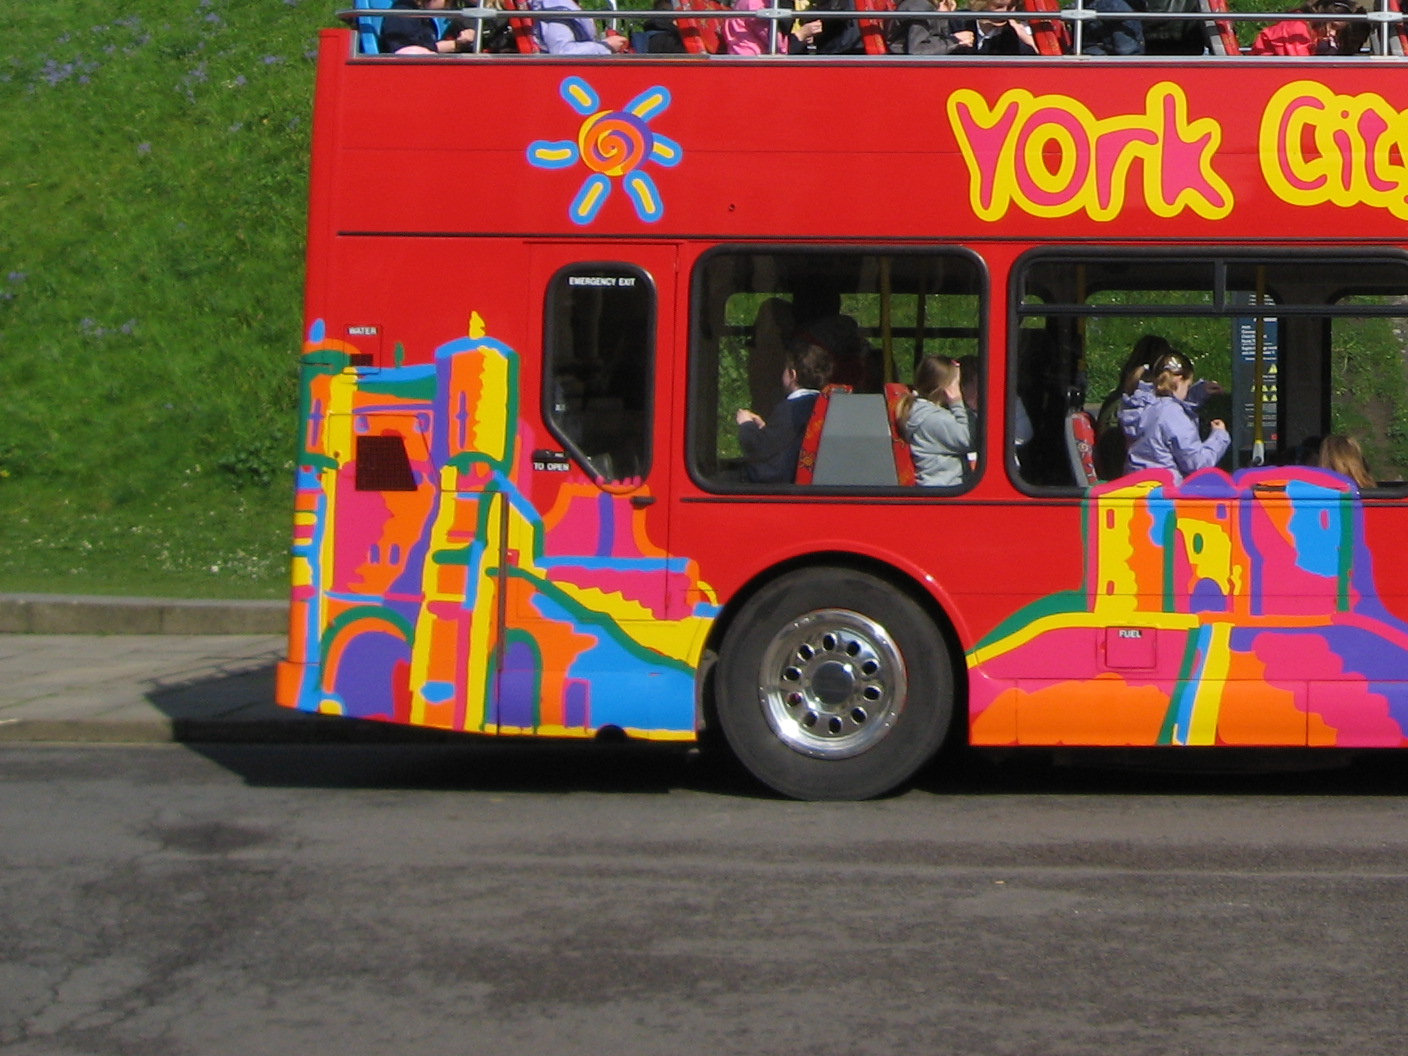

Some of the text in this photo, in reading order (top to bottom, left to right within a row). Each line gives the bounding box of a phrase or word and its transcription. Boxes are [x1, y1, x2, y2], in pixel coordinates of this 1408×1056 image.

[948, 82, 1234, 222] York
[568, 276, 636, 287] EMERGENCY EXIT
[348, 326, 377, 335] WATER
[533, 462, 570, 471] TO OPEN
[1119, 629, 1141, 638] FUEL
